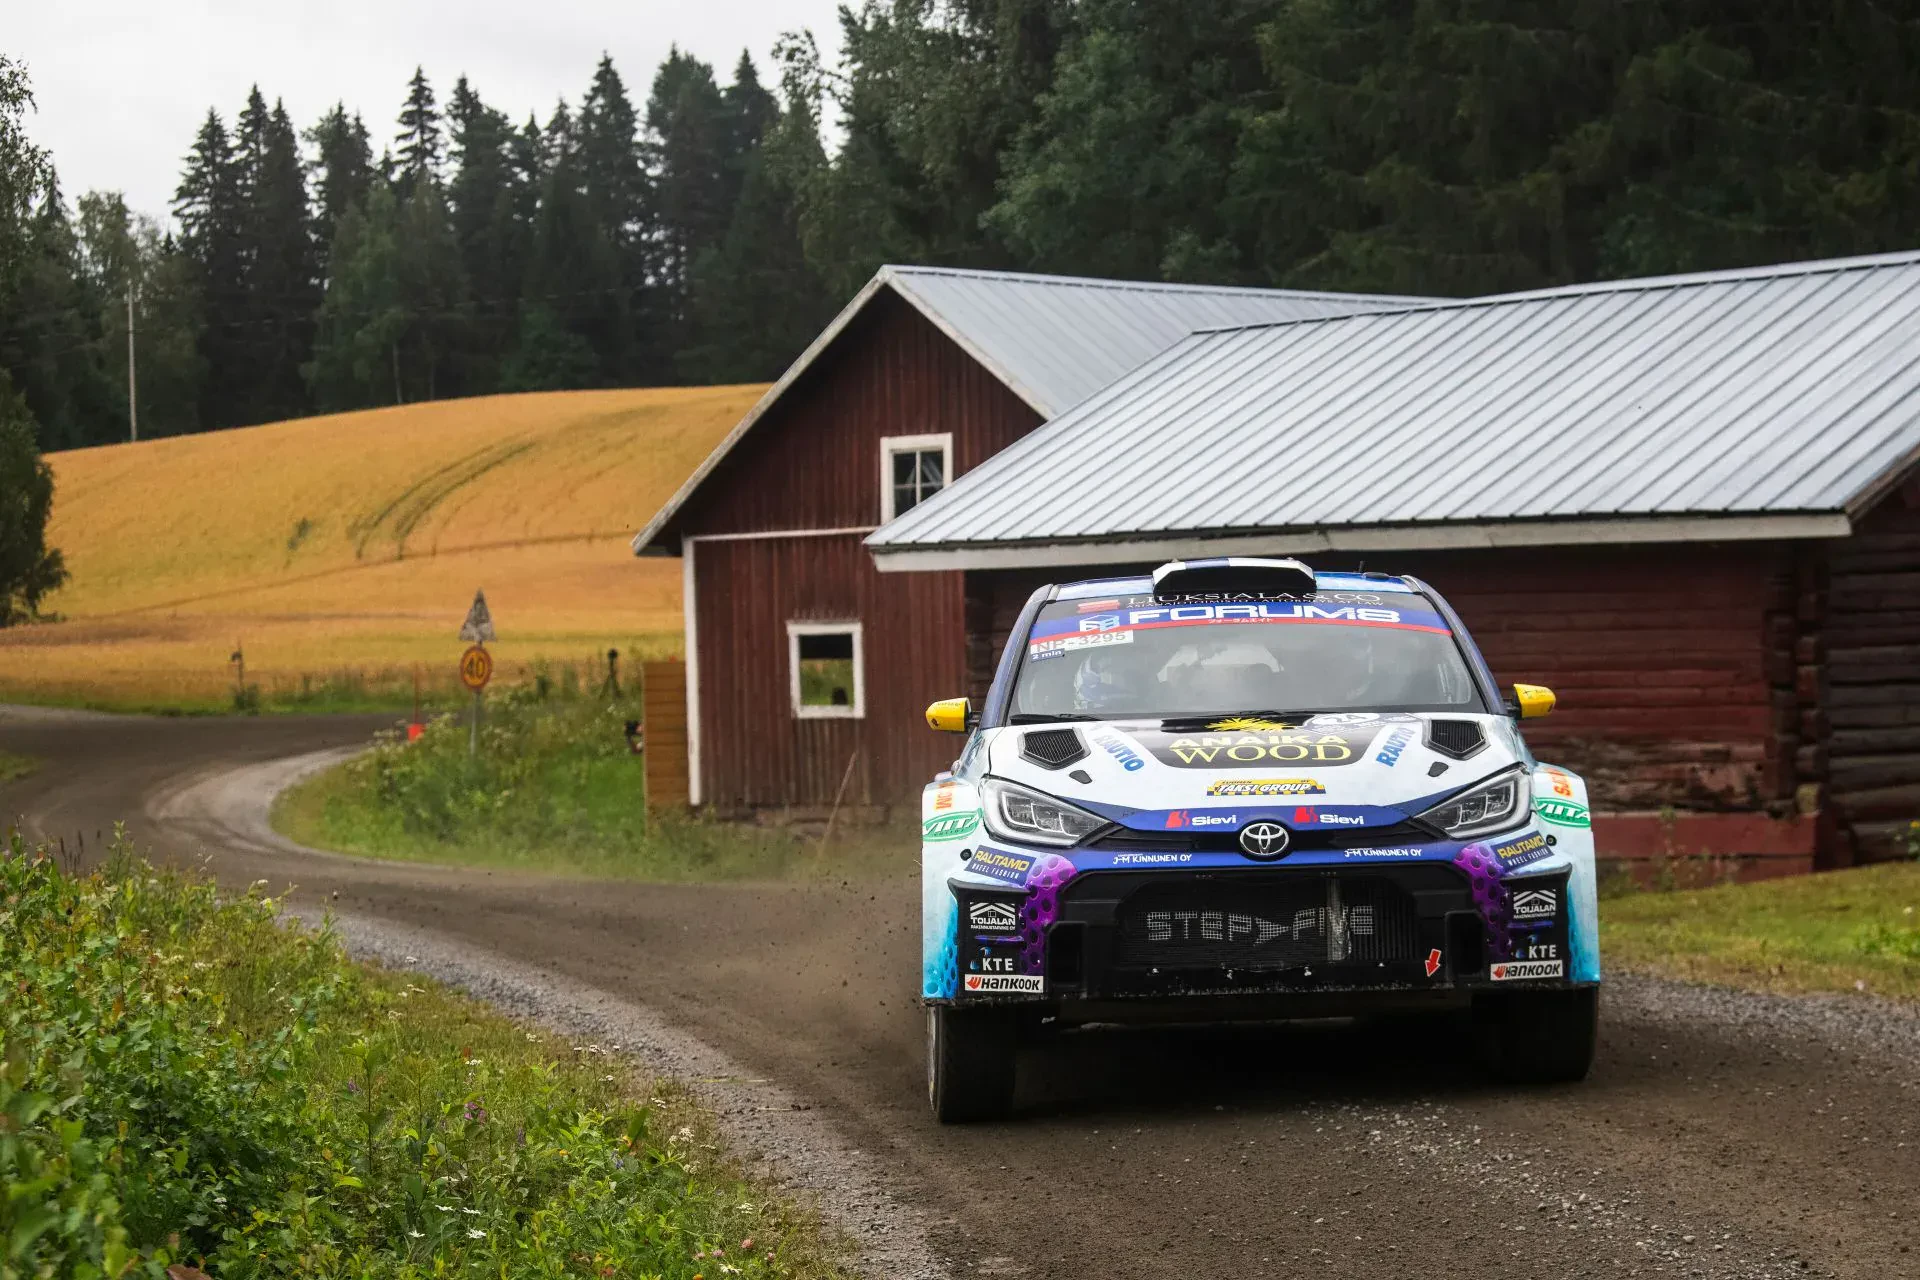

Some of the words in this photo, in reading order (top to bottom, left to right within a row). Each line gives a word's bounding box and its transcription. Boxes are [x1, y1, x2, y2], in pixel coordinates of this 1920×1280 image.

[1129, 605, 1400, 625] FORUM8
[1036, 631, 1127, 651] NP-3295
[1041, 649, 1062, 659] min
[465, 656, 486, 679] 40
[1168, 734, 1348, 749] ANAIKA
[1173, 744, 1352, 764] WOOD
[1259, 783, 1312, 792] GROUP
[1191, 814, 1237, 826] Sievi
[1319, 813, 1364, 825] Sievi
[1362, 848, 1409, 857] KINNUNEN
[1410, 848, 1422, 857] OY
[1496, 834, 1545, 860] RAUTAMO
[975, 850, 1030, 872] RAUTAMO
[1132, 853, 1178, 863] KINNUNEN
[1179, 853, 1192, 862] OY
[1146, 910, 1252, 942] STEP
[1528, 944, 1557, 959] KTE
[982, 957, 1014, 972] KTE
